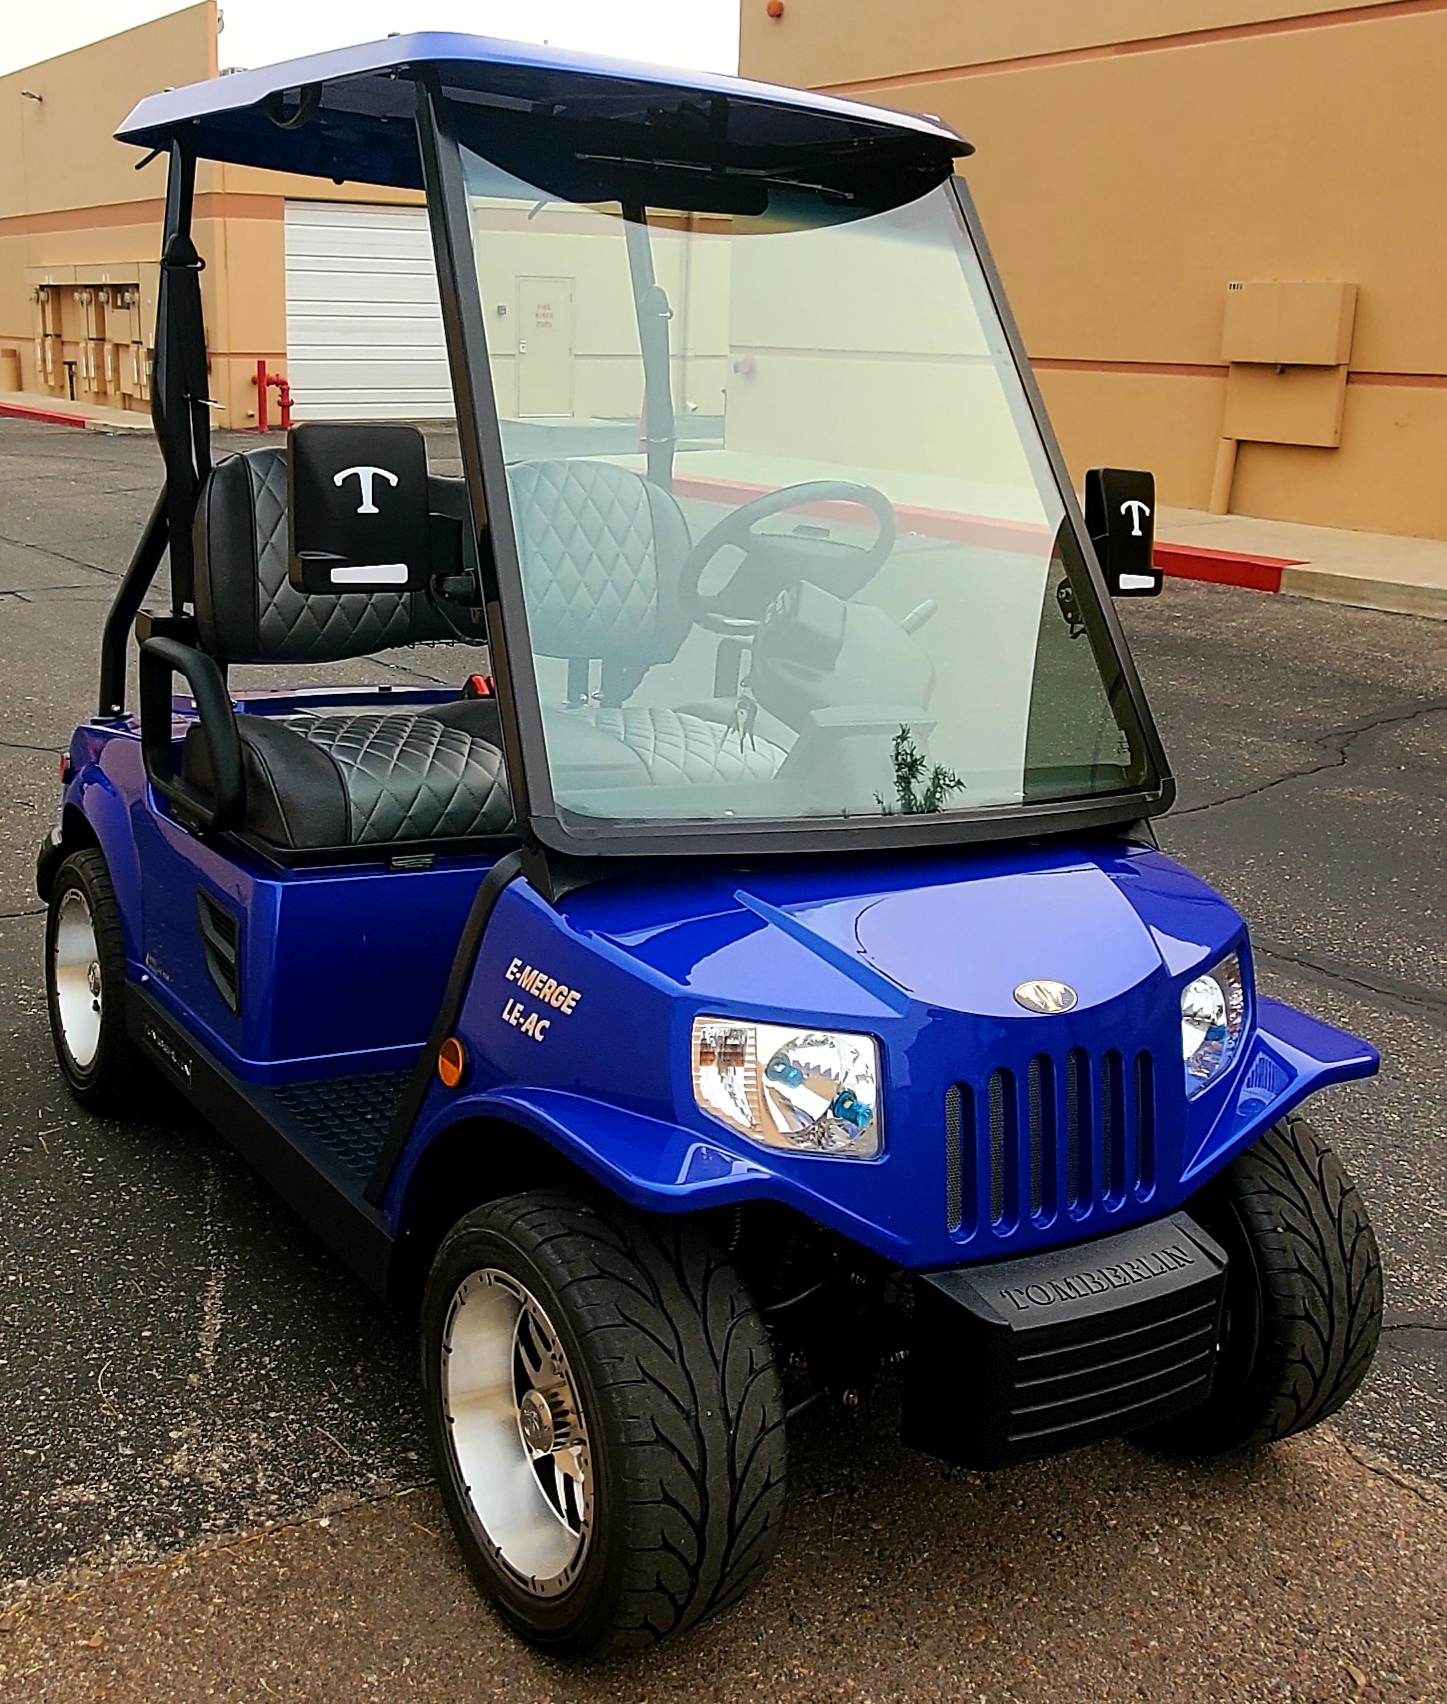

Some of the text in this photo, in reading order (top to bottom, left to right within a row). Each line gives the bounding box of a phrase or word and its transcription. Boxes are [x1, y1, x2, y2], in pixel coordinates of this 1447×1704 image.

[334, 466, 398, 513] T
[1120, 500, 1150, 536] T
[505, 957, 582, 1015] E-MERGE
[502, 998, 551, 1042] LE-AC
[1000, 1245, 1195, 1310] TOMBERLIN
